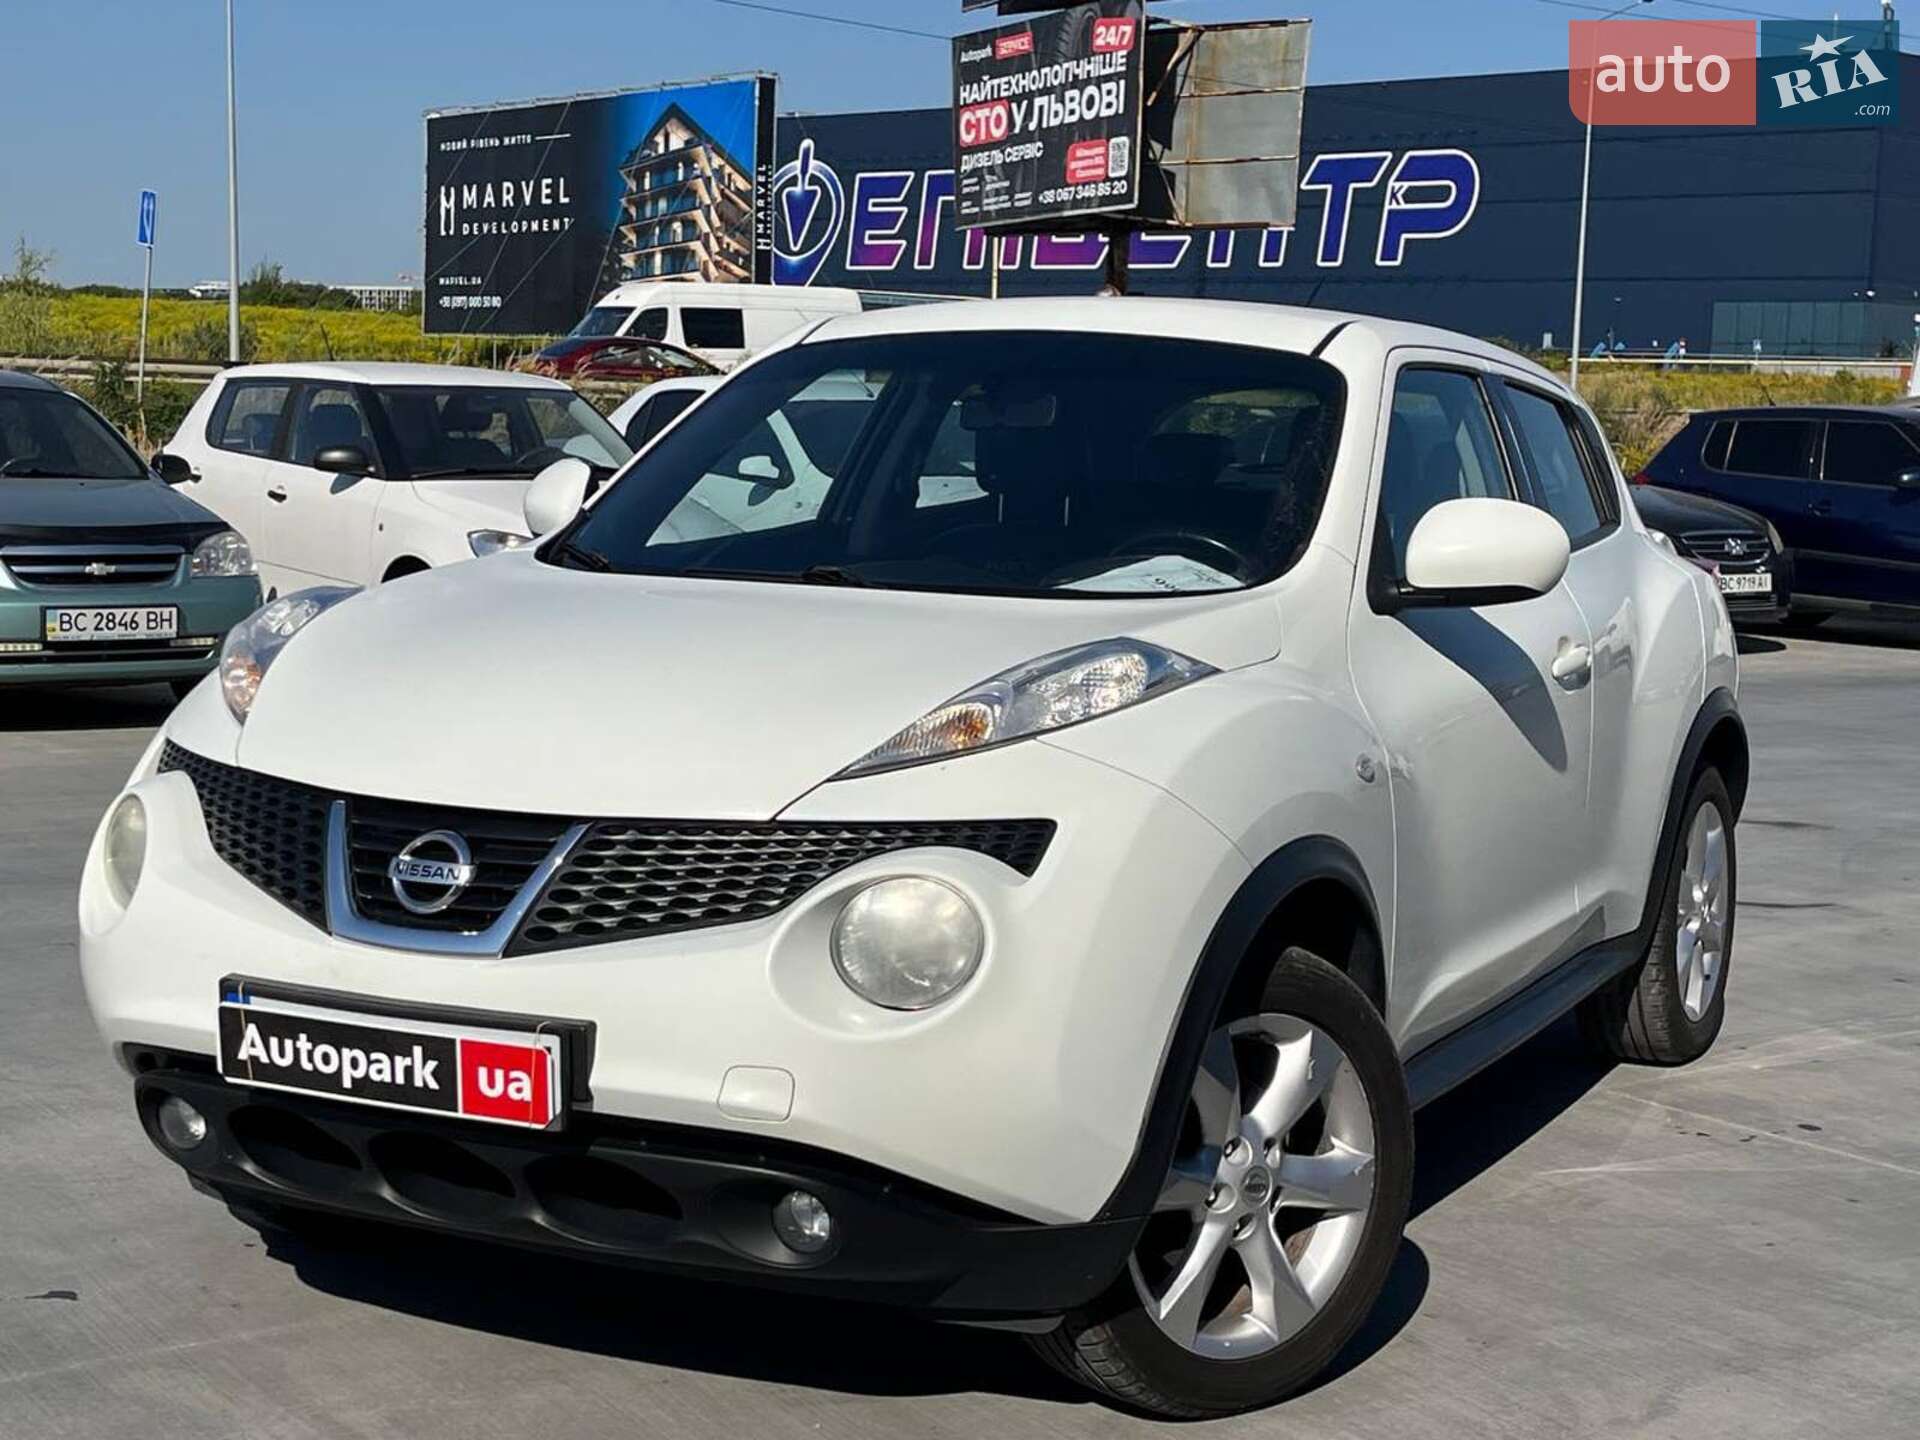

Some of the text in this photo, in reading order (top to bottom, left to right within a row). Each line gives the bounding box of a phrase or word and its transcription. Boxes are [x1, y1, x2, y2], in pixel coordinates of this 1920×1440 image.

[1094, 25, 1133, 46] 24/7
[960, 79, 1125, 143] СТО У ЛЬВОВІ
[961, 148, 1003, 173] ДИЗЕЛЬ
[1005, 141, 1044, 164] СЕРВІС
[462, 177, 570, 209] MARVEL
[756, 164, 766, 234] MARVEL
[1112, 180, 1127, 194] 20
[462, 218, 570, 235] DEVELOPMENT
[59, 611, 173, 632] BC 2846 BH
[394, 862, 460, 881] NISSAN
[237, 1023, 532, 1103] Autopark ua
